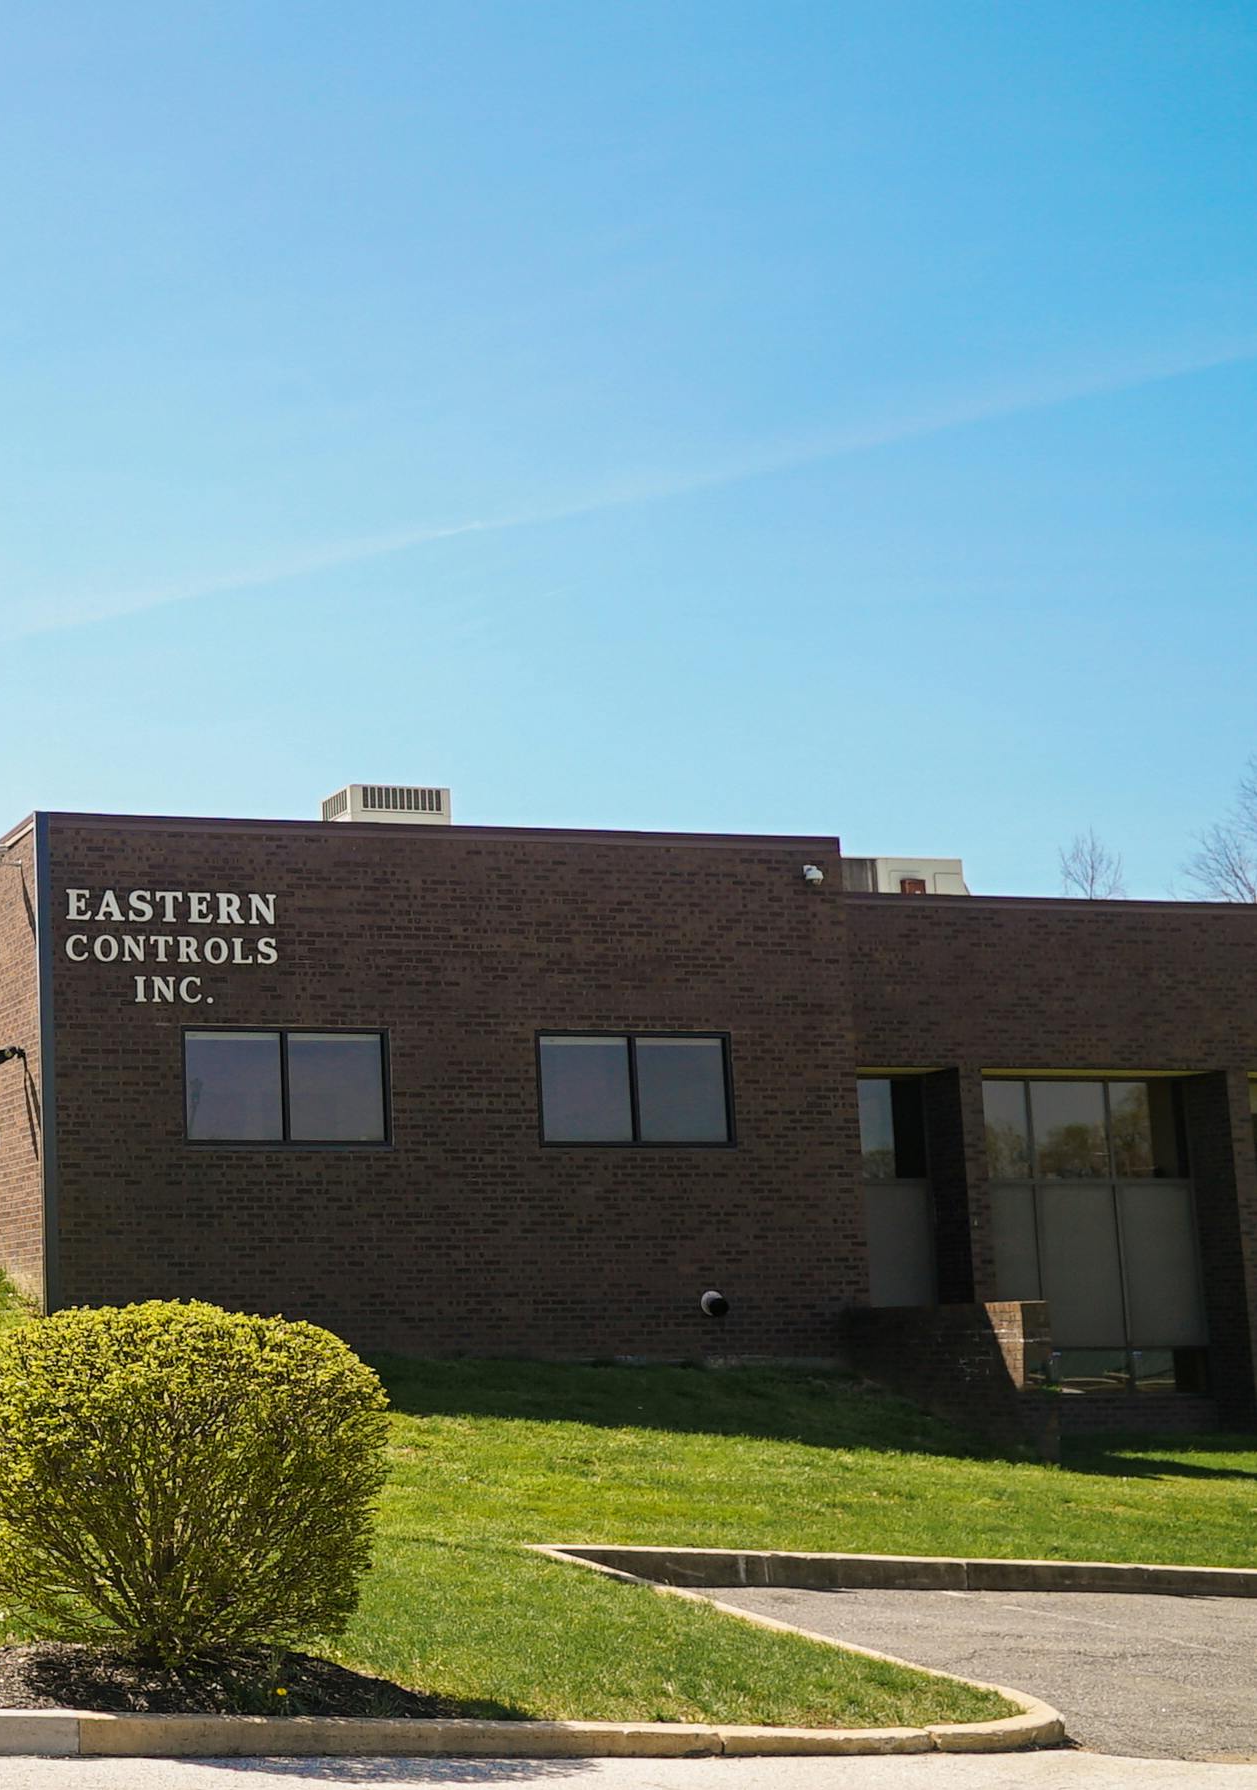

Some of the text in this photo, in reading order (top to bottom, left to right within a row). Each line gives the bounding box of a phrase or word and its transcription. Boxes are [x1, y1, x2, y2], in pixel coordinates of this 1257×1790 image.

[65, 888, 278, 925] EASTERN
[65, 934, 279, 965] CONTROLS
[134, 975, 215, 1005] INC.
